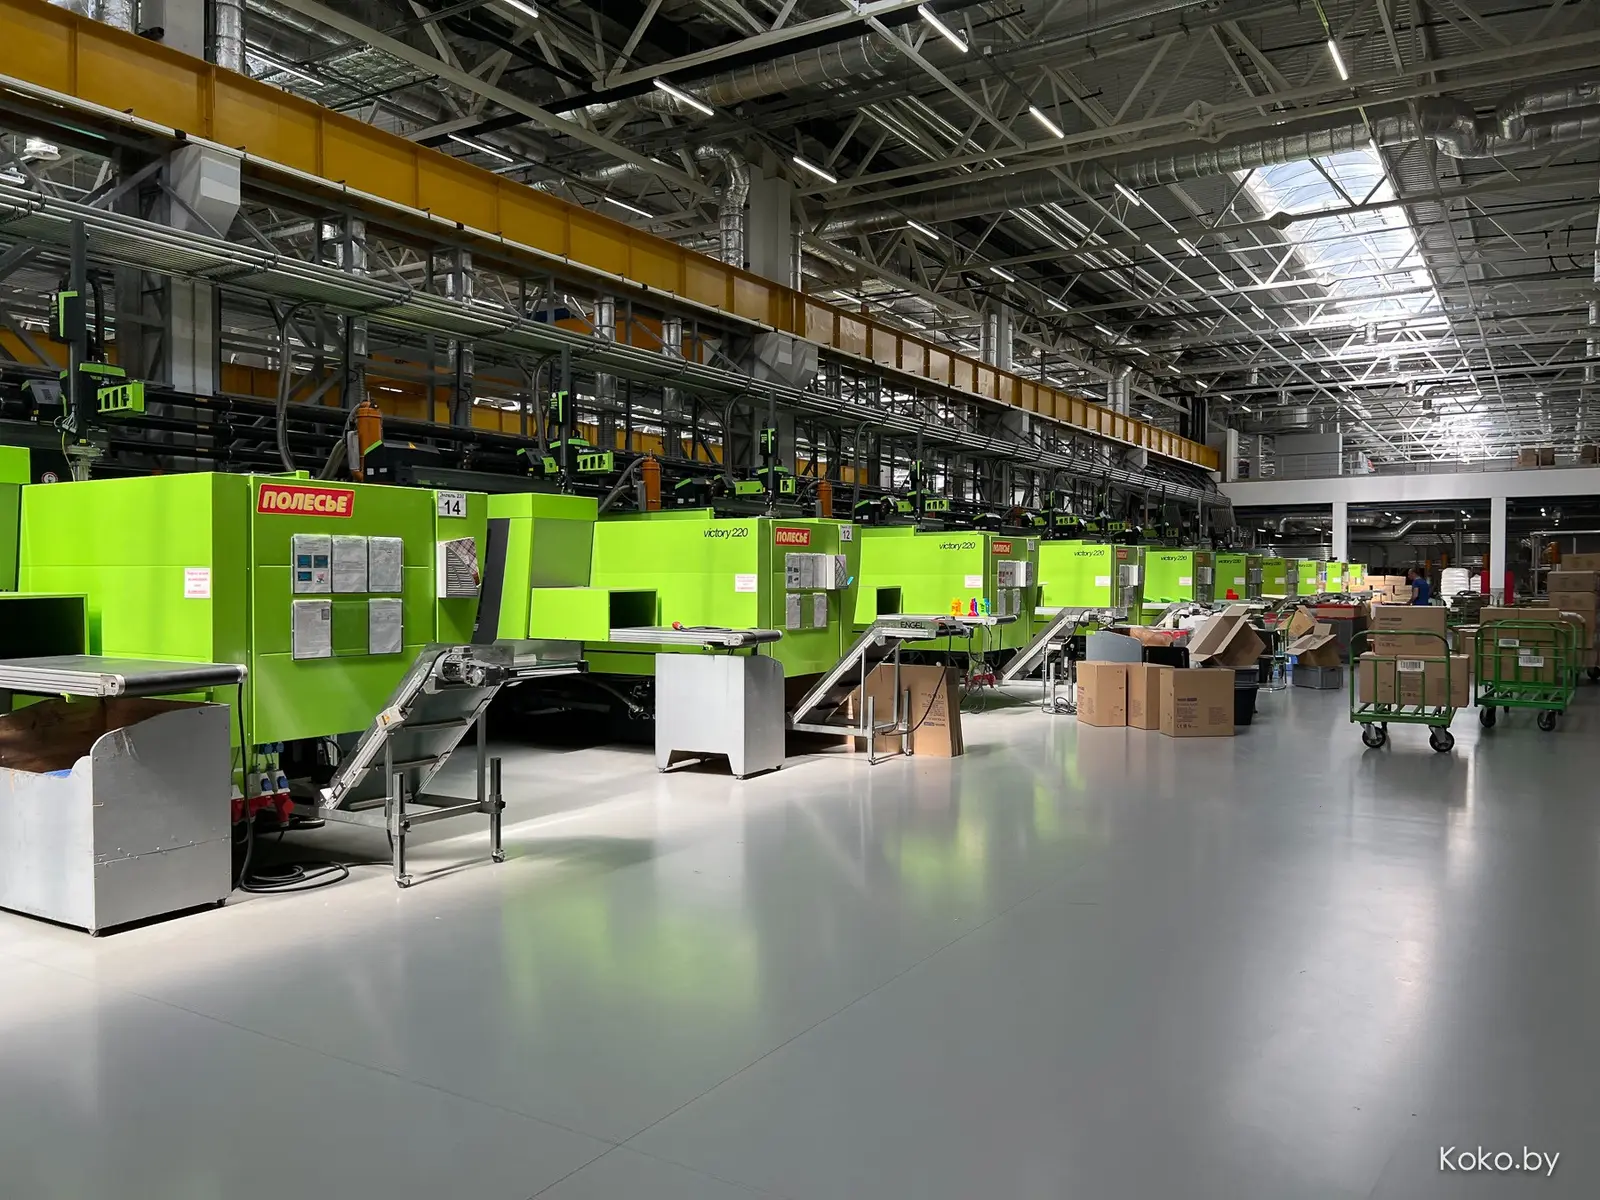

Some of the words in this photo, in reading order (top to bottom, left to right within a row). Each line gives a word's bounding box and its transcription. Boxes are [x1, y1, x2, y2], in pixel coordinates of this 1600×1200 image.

[262, 491, 348, 513] ПОЛЕСЬЕ
[444, 499, 461, 515] 14
[703, 528, 731, 540] victory
[731, 527, 748, 538] 220
[776, 531, 808, 544] ПОЛЕСЬЕ
[842, 530, 851, 540] 12
[939, 542, 962, 551] victory
[961, 541, 976, 550] 220
[900, 621, 924, 630] ENGEL
